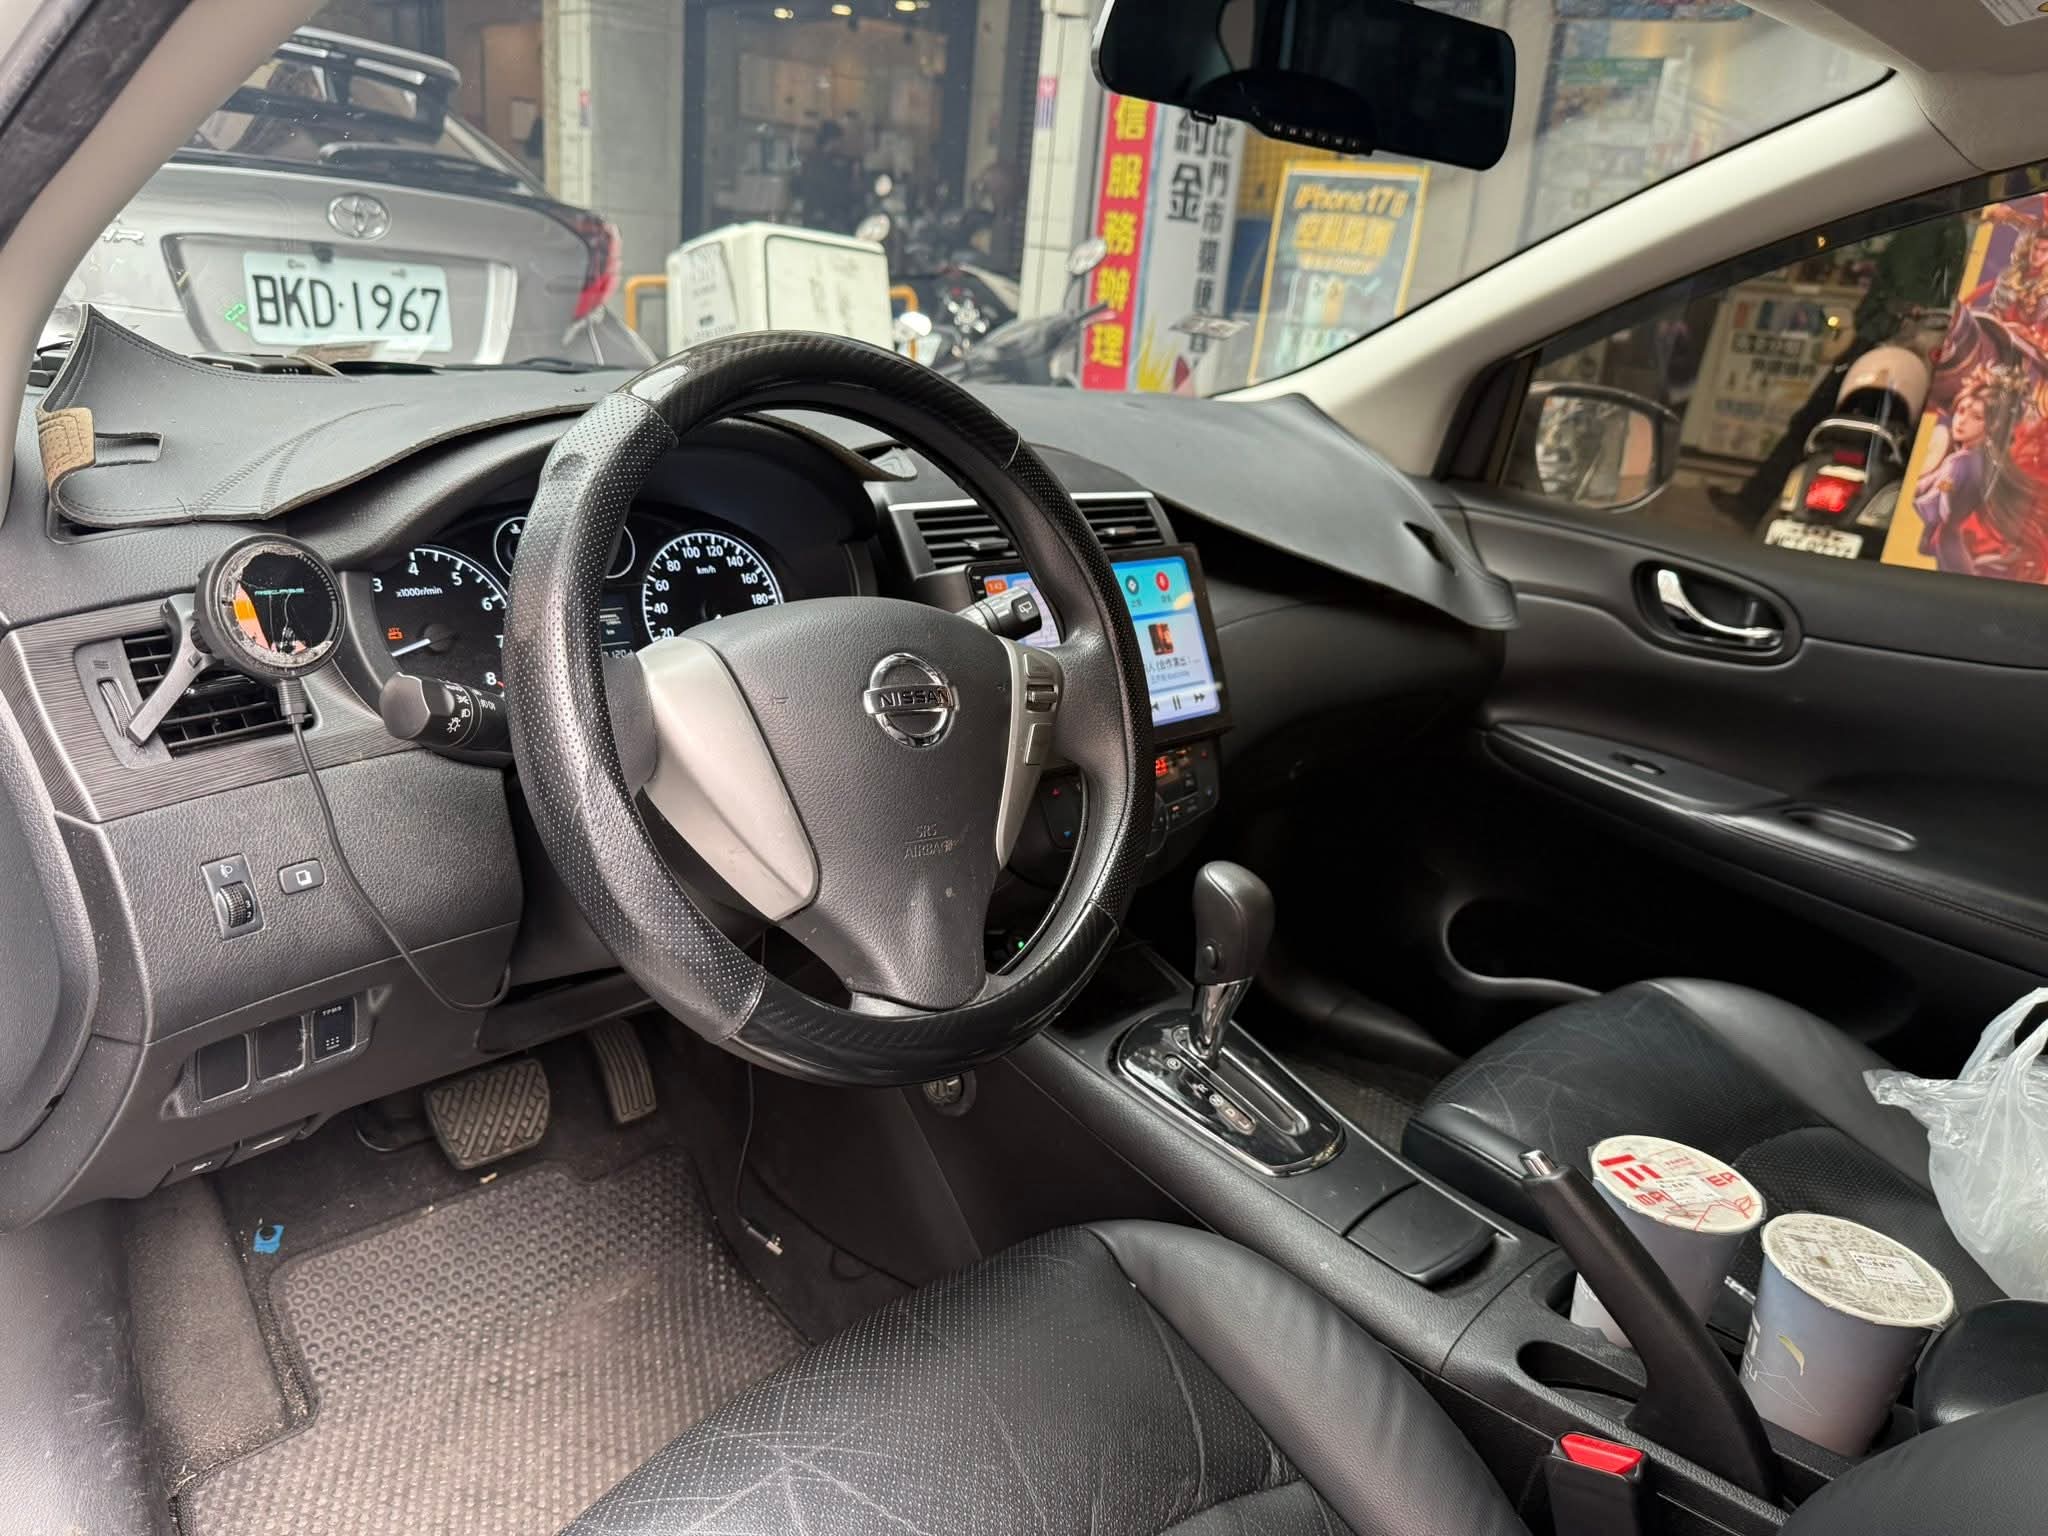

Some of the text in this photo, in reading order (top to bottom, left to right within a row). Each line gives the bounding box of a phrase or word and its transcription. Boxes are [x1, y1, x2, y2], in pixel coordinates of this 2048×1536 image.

[682, 546, 700, 559] 100
[706, 545, 724, 557] 120
[666, 559, 681, 572] 80
[726, 555, 744, 568] 140
[408, 562, 419, 576] 4
[696, 565, 717, 575] km/h
[372, 578, 384, 592] 3
[452, 572, 463, 586] 5
[655, 579, 669, 592] 60
[741, 573, 758, 585] 160
[481, 597, 493, 611] 6
[751, 593, 768, 606] 180
[654, 602, 668, 615] 40
[660, 628, 674, 639] 20
[485, 671, 497, 686] 8
[880, 687, 954, 709] NISSAN
